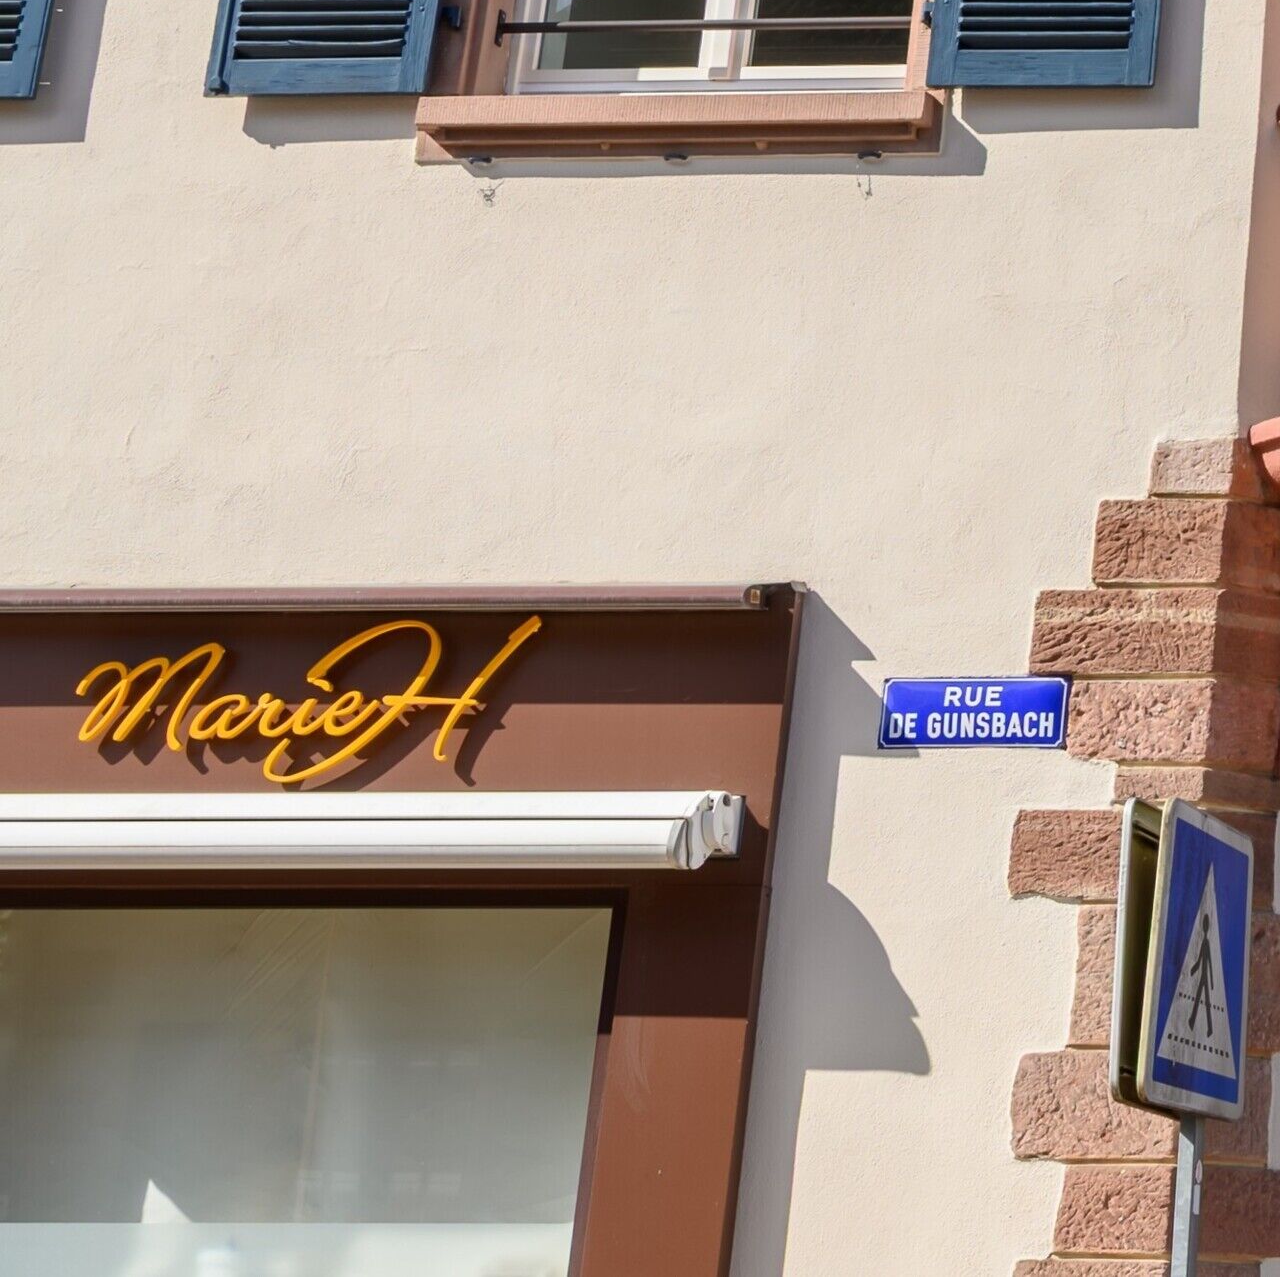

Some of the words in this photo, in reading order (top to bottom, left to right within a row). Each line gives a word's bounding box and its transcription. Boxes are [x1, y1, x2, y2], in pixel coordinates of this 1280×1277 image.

[943, 686, 1004, 707] RUE
[888, 712, 918, 739] DE
[926, 711, 1054, 739] GUNSBACH
